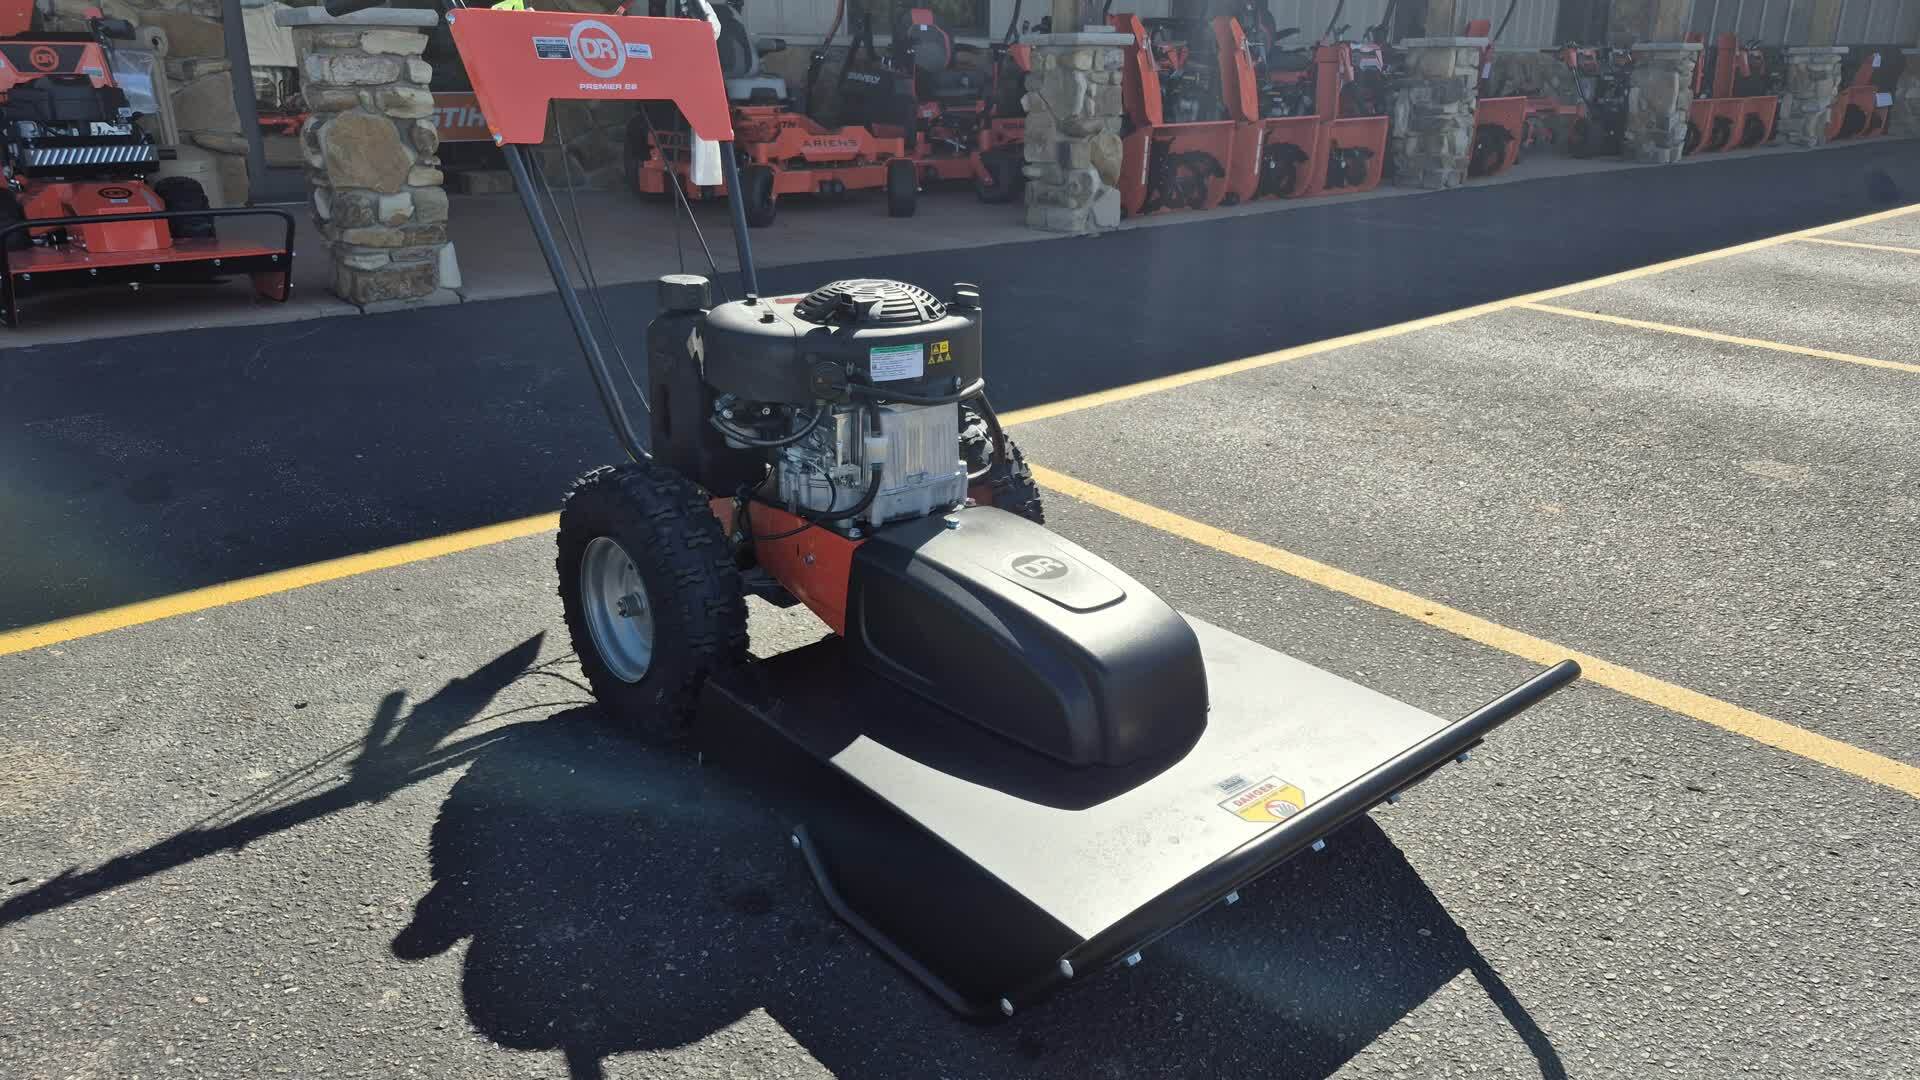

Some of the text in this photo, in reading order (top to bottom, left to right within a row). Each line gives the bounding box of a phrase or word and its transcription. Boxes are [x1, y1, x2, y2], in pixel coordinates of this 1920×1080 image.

[580, 38, 617, 59] DR
[432, 107, 486, 128] STIH
[803, 139, 859, 148] ARIENS
[1014, 558, 1065, 577] DR
[1232, 783, 1277, 807] DANGER
